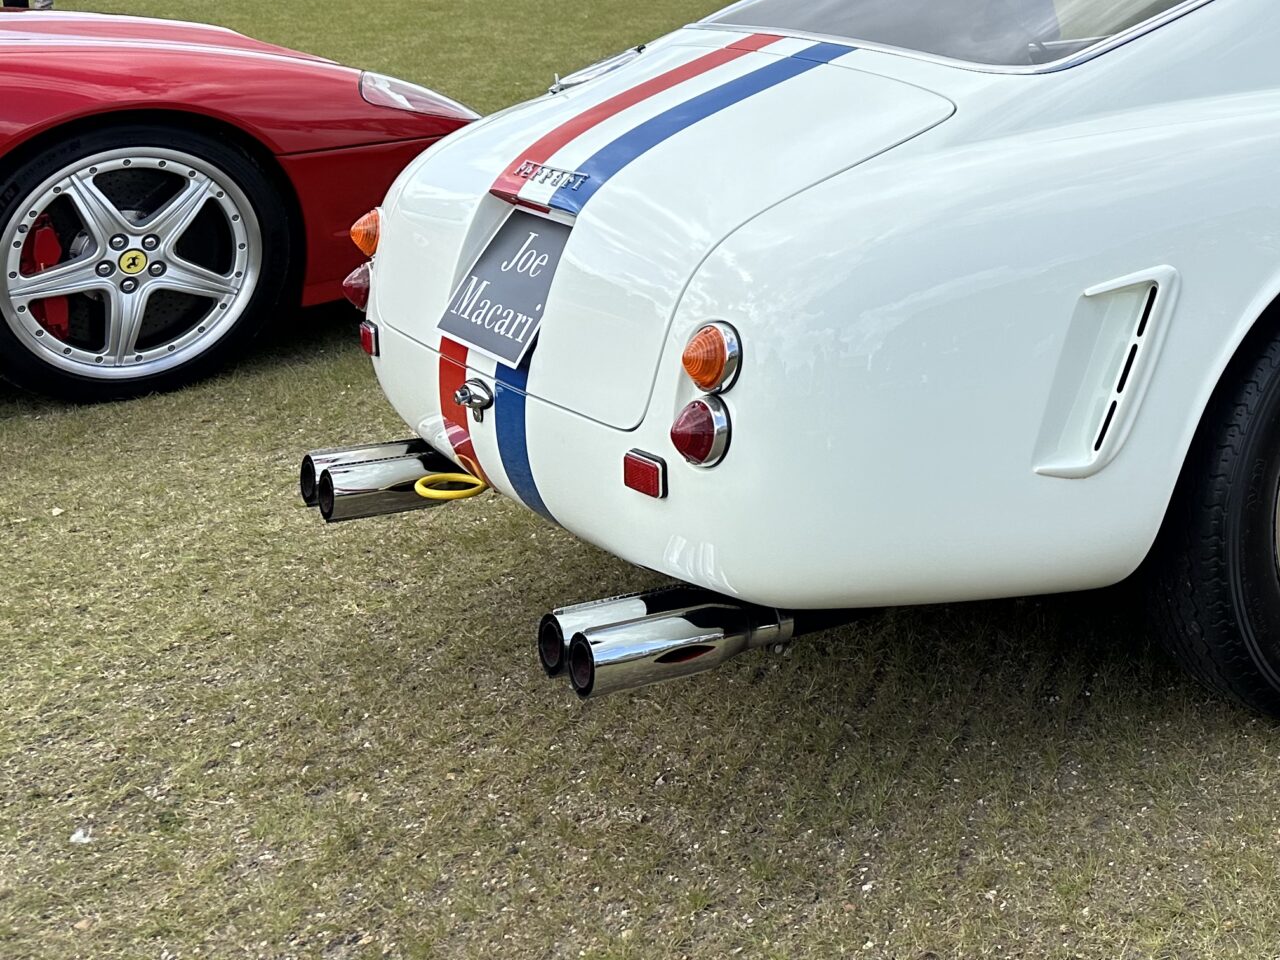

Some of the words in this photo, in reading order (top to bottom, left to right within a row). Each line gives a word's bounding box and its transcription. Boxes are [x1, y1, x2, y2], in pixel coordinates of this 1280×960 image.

[513, 159, 591, 191] Ferrari
[501, 231, 549, 278] Joe
[450, 275, 542, 343] Macari
